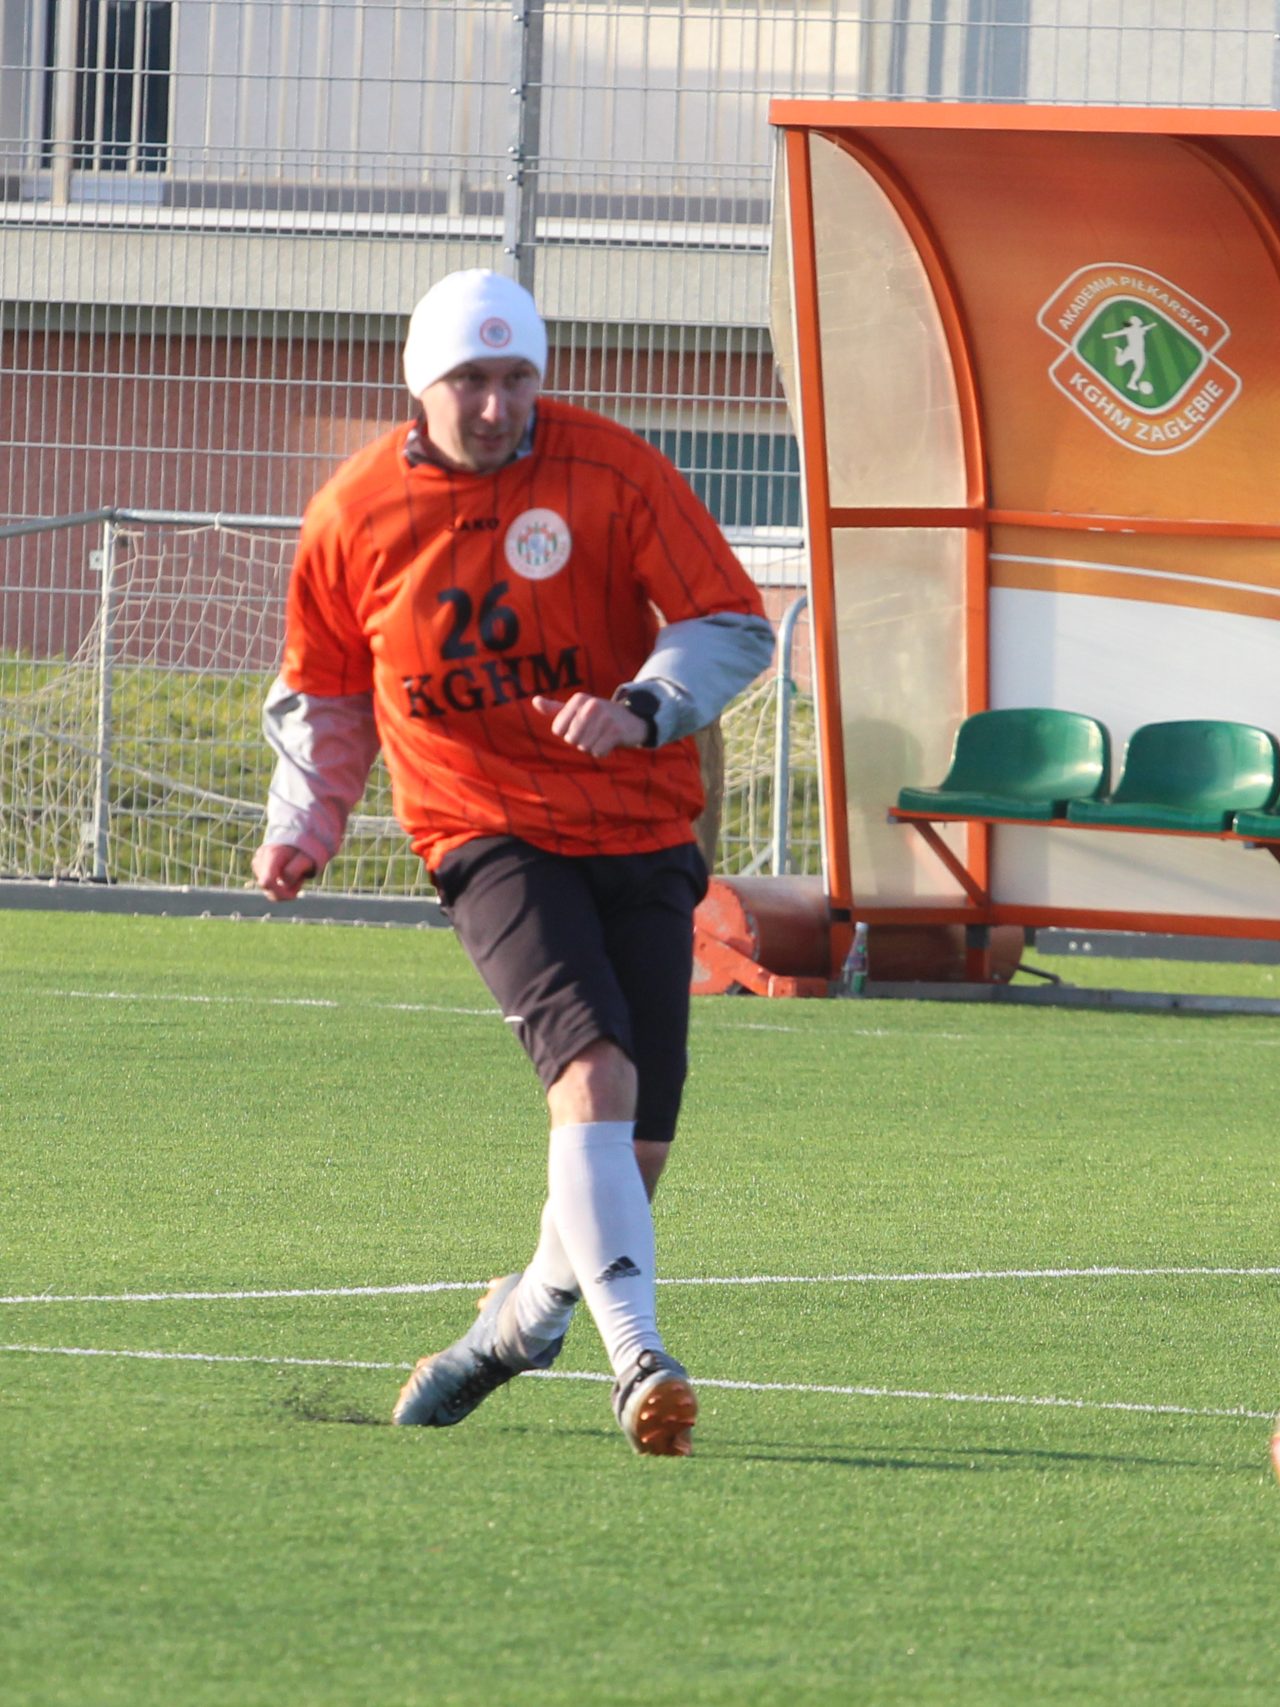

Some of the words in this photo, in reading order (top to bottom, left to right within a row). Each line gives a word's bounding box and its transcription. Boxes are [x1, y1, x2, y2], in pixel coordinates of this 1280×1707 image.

[1058, 276, 1119, 331] AKADEMIA
[1120, 276, 1210, 337] PIŁKARSKA
[1069, 372, 1132, 431] KGHM
[1135, 379, 1224, 442] ZAGŁĘBIE
[437, 580, 520, 661] 26
[401, 645, 584, 719] KGHM
